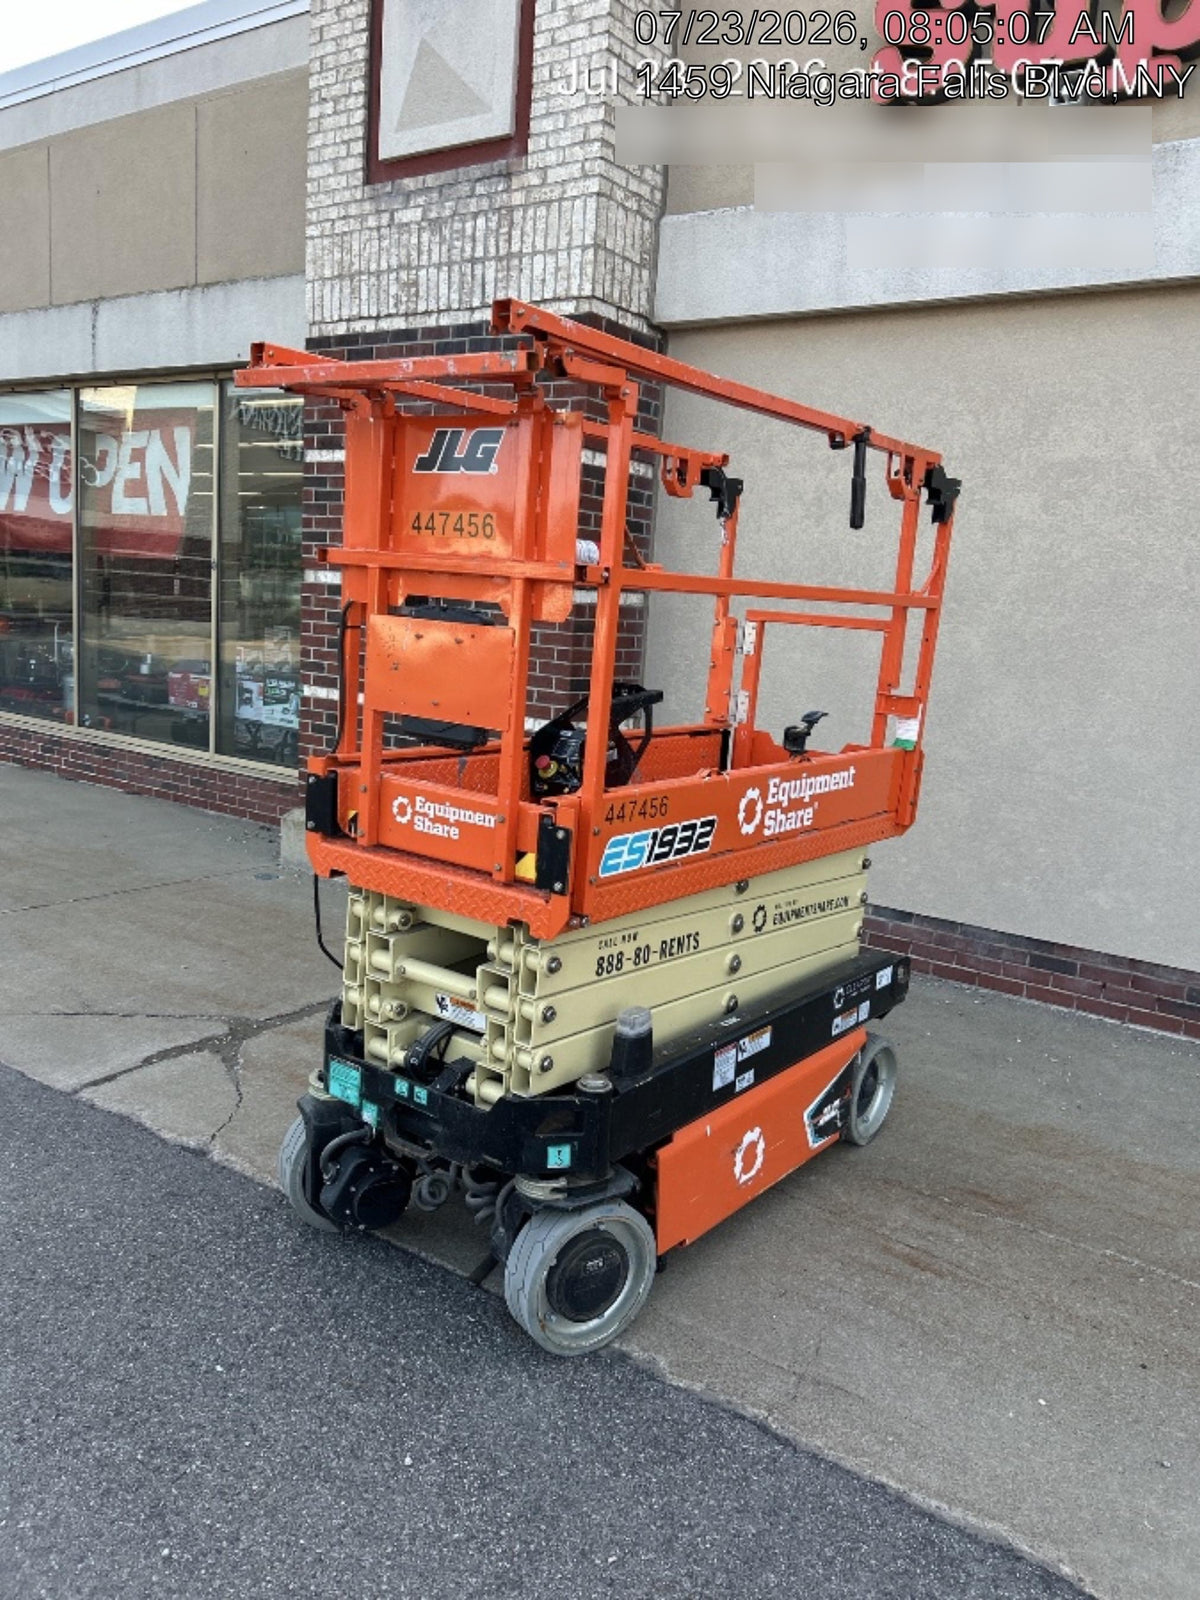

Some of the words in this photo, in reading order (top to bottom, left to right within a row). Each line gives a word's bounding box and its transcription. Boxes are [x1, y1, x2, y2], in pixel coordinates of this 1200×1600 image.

[412, 427, 506, 474] JLG
[411, 511, 495, 539] 447456
[766, 766, 857, 807] Equipment
[414, 796, 496, 828] Equipmen
[604, 795, 669, 825] 447456
[763, 807, 813, 836] Share
[413, 815, 460, 840] Share
[599, 815, 718, 877] ES1932
[595, 930, 700, 977] 888-80-RENTS
